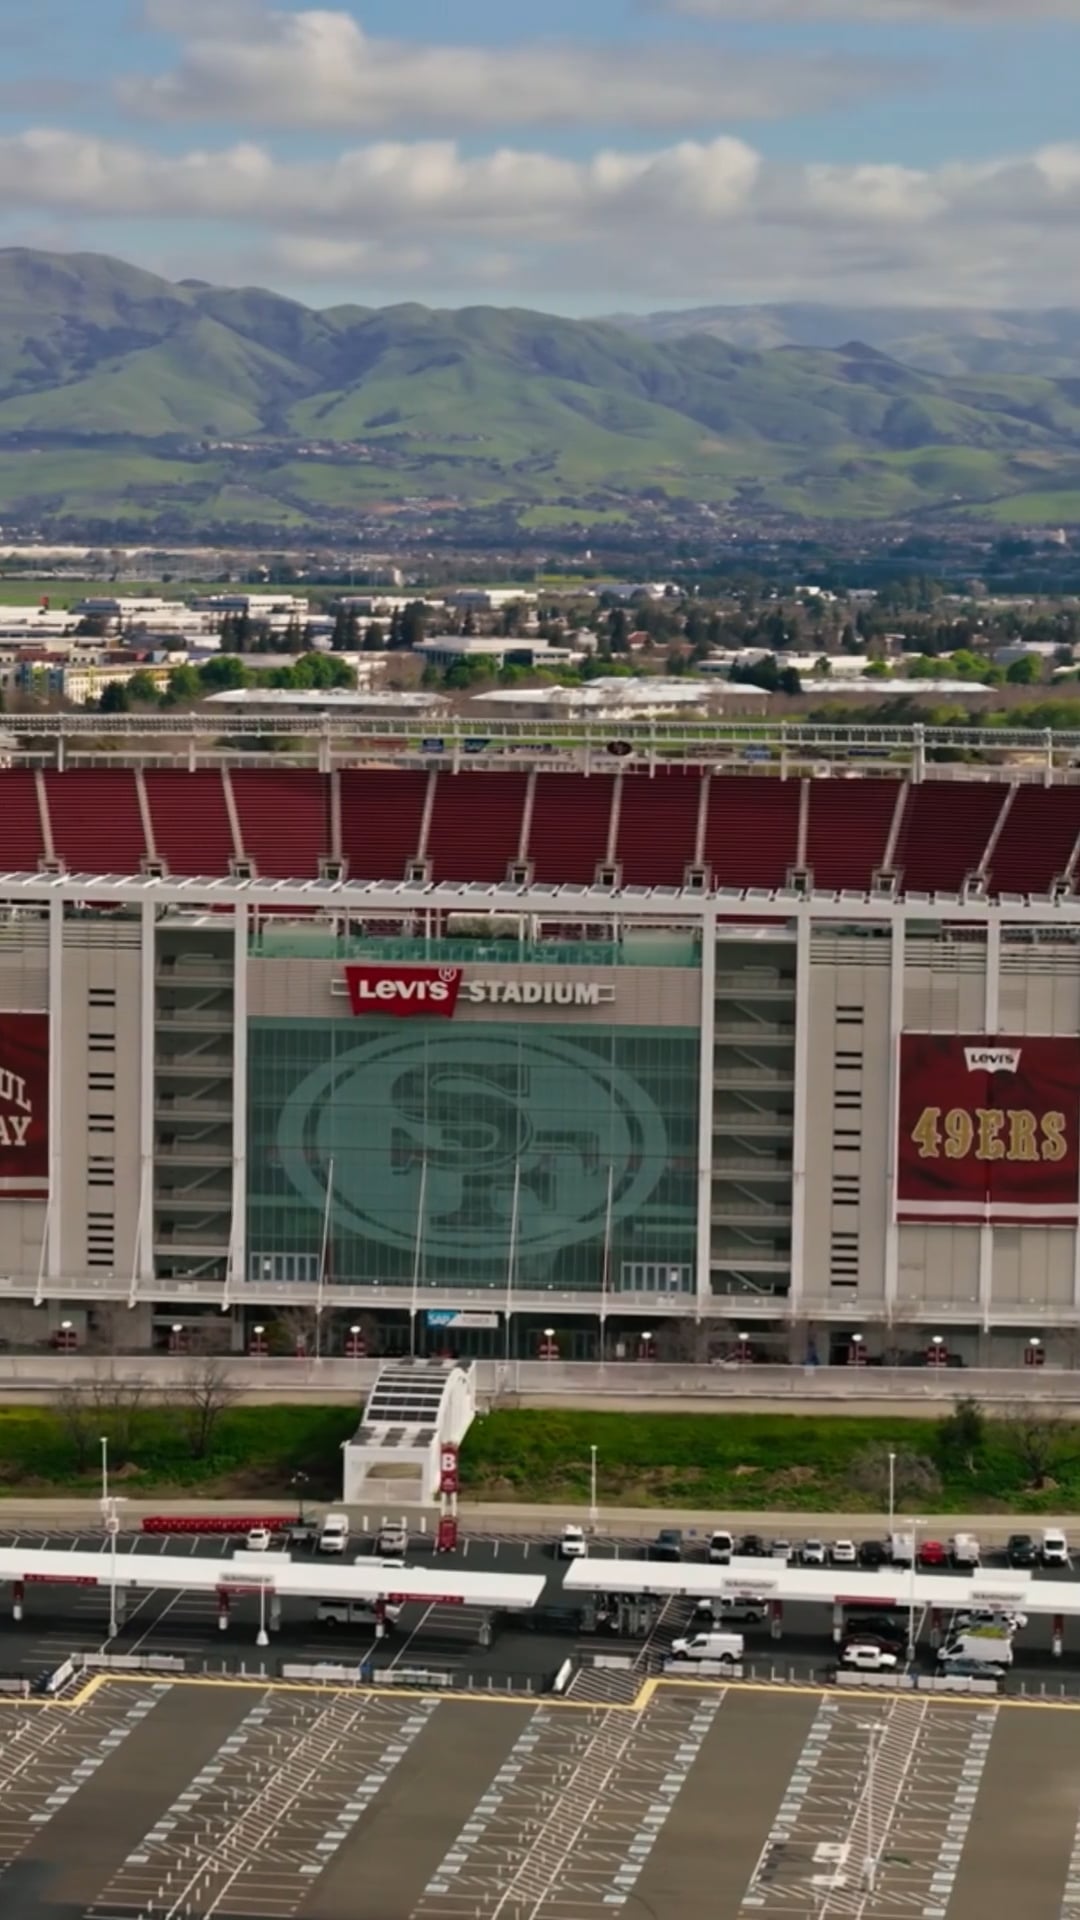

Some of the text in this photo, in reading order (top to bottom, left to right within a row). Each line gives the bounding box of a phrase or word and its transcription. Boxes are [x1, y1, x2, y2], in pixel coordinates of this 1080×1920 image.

[469, 980, 600, 1004] STADIUM
[911, 1107, 1067, 1161] 49ERS
[442, 1453, 456, 1471] B
